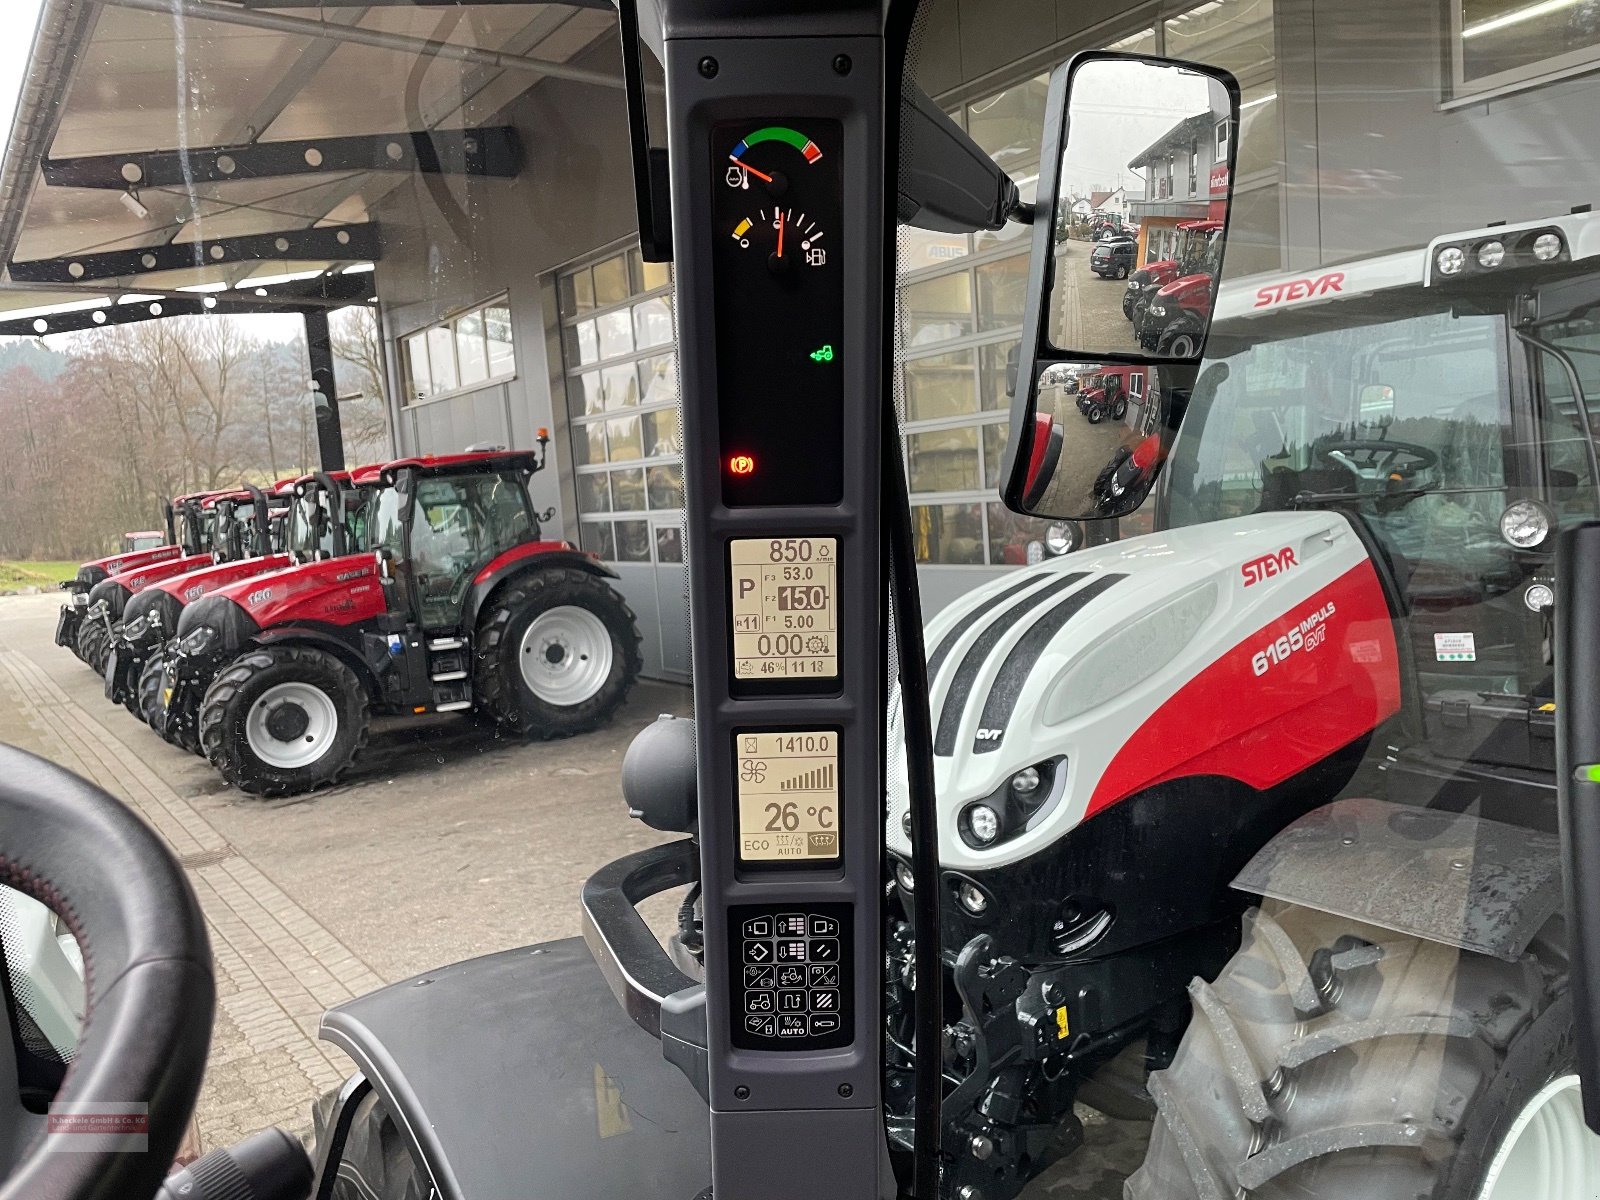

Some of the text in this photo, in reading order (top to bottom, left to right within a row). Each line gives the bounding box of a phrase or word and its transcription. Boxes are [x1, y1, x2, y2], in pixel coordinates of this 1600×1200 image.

[1254, 272, 1344, 307] STEYR
[770, 540, 812, 562] 850
[783, 567, 813, 580] 53.0
[1242, 547, 1299, 588] STEYR
[740, 579, 755, 599] P
[782, 587, 824, 610] 15.0
[784, 615, 814, 629] 5.00
[758, 634, 803, 656] 0.00
[1252, 626, 1304, 677] 6165
[1300, 602, 1336, 634] IMPULS
[1304, 623, 1326, 652] CVT
[776, 736, 829, 752] 1410.0
[976, 729, 1002, 740] CVT
[765, 802, 800, 831] 26
[744, 840, 769, 850] ECO
